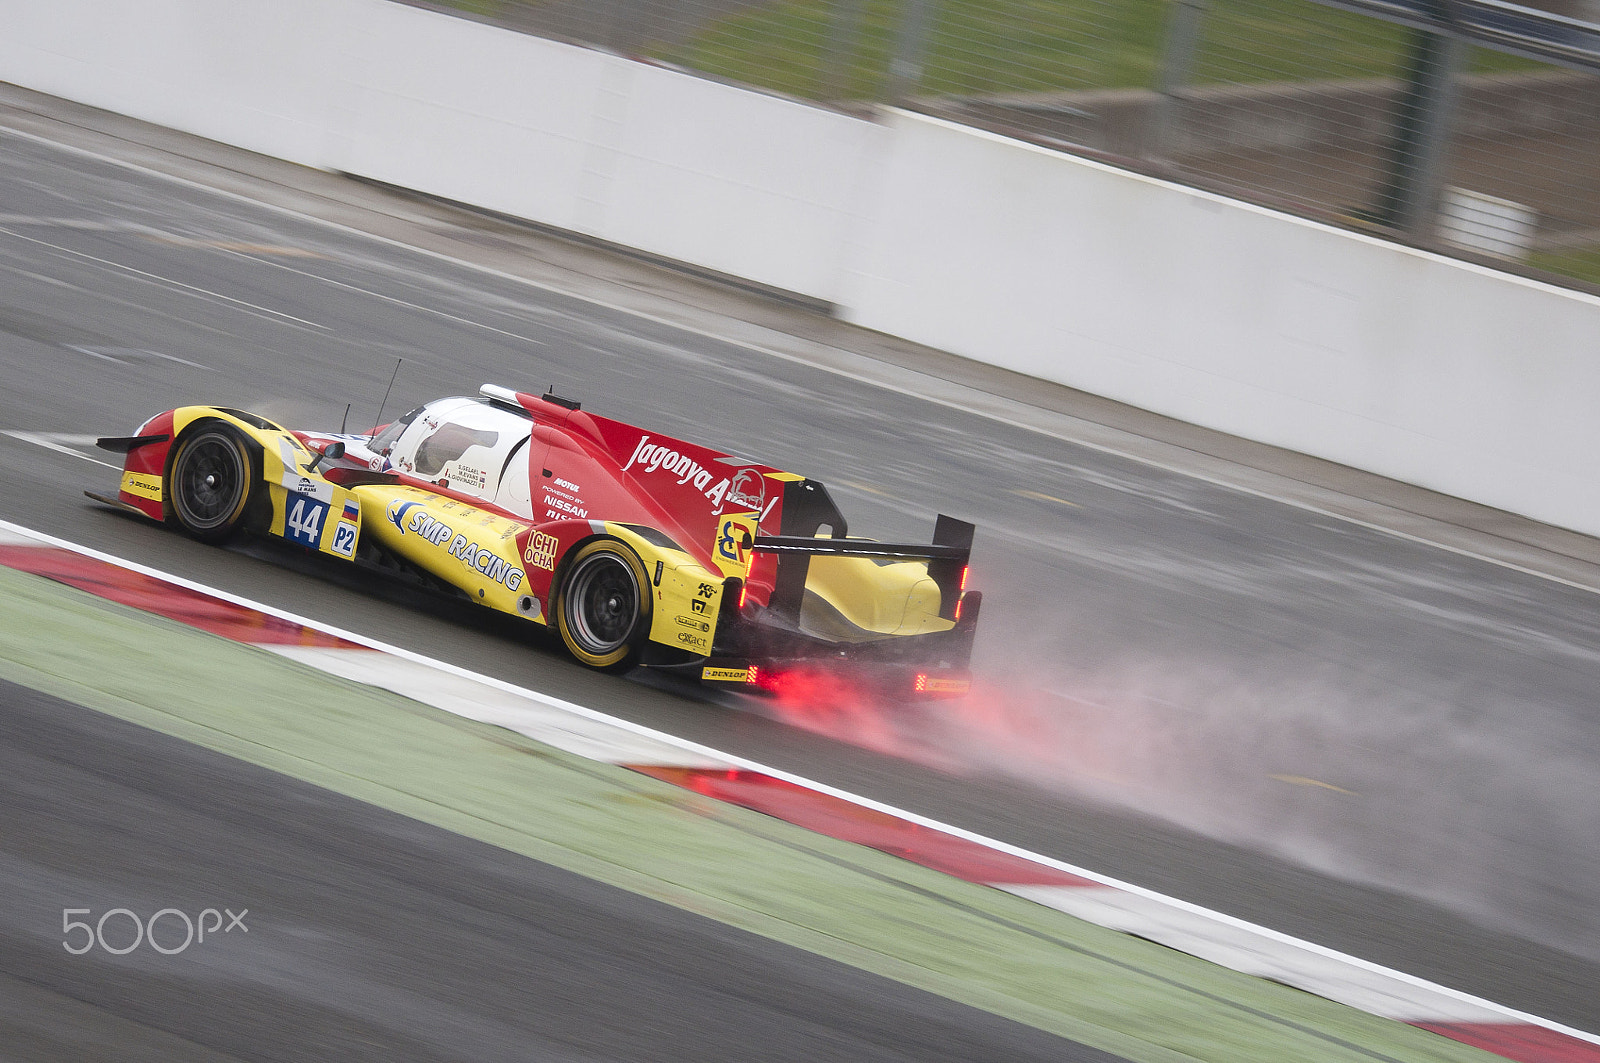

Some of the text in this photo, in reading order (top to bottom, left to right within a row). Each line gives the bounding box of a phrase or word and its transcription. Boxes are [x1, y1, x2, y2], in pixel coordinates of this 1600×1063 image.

[621, 435, 713, 492] Jagonya
[135, 481, 160, 491] DUNLOP
[542, 485, 574, 501] POWERED
[553, 477, 580, 493] MOTUL
[543, 495, 589, 519] NISSAN
[288, 500, 323, 543] 44
[334, 527, 354, 551] P2
[528, 530, 559, 556] ICHI
[408, 511, 525, 592] SMP RACING
[524, 548, 555, 571] OCHA
[711, 670, 746, 678] DUNLOP
